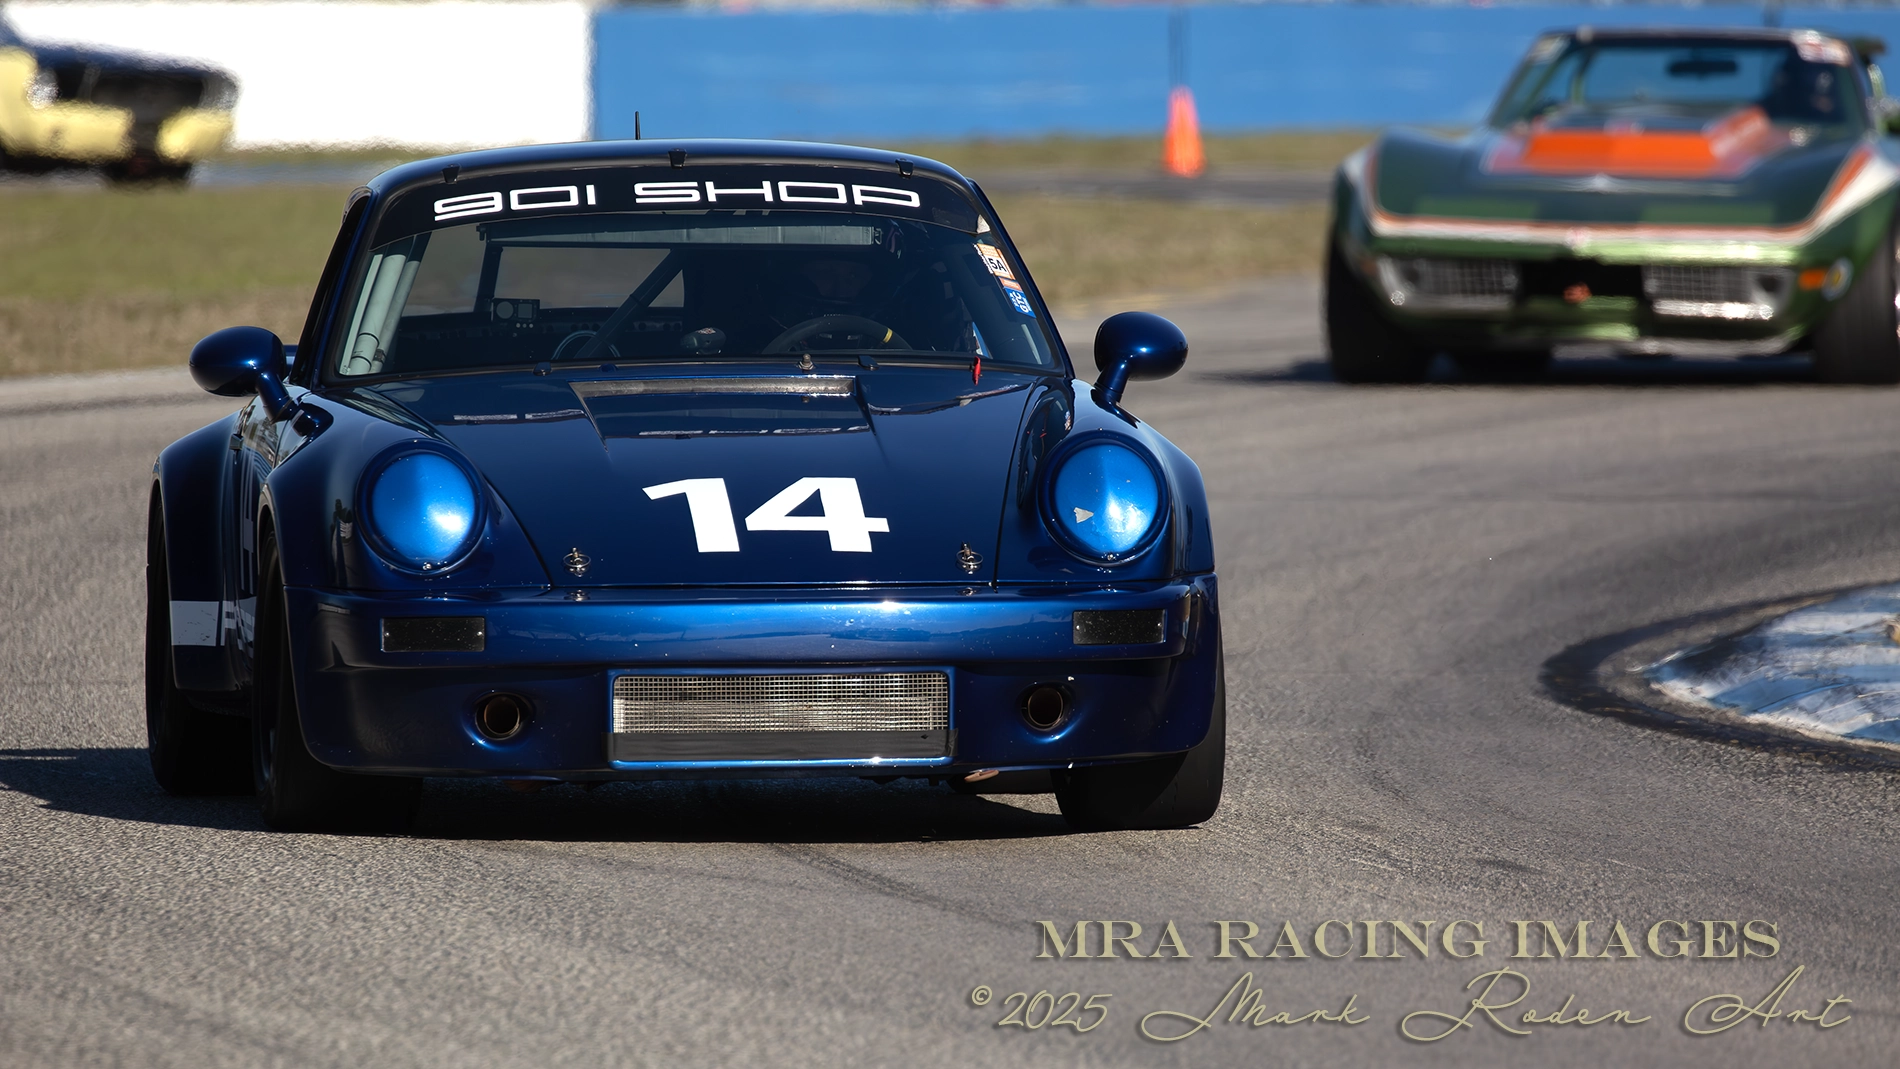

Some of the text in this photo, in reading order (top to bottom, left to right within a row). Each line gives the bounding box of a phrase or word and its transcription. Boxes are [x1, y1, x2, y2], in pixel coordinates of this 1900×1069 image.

[434, 180, 921, 222] 901 SHOP
[643, 477, 889, 552] 14
